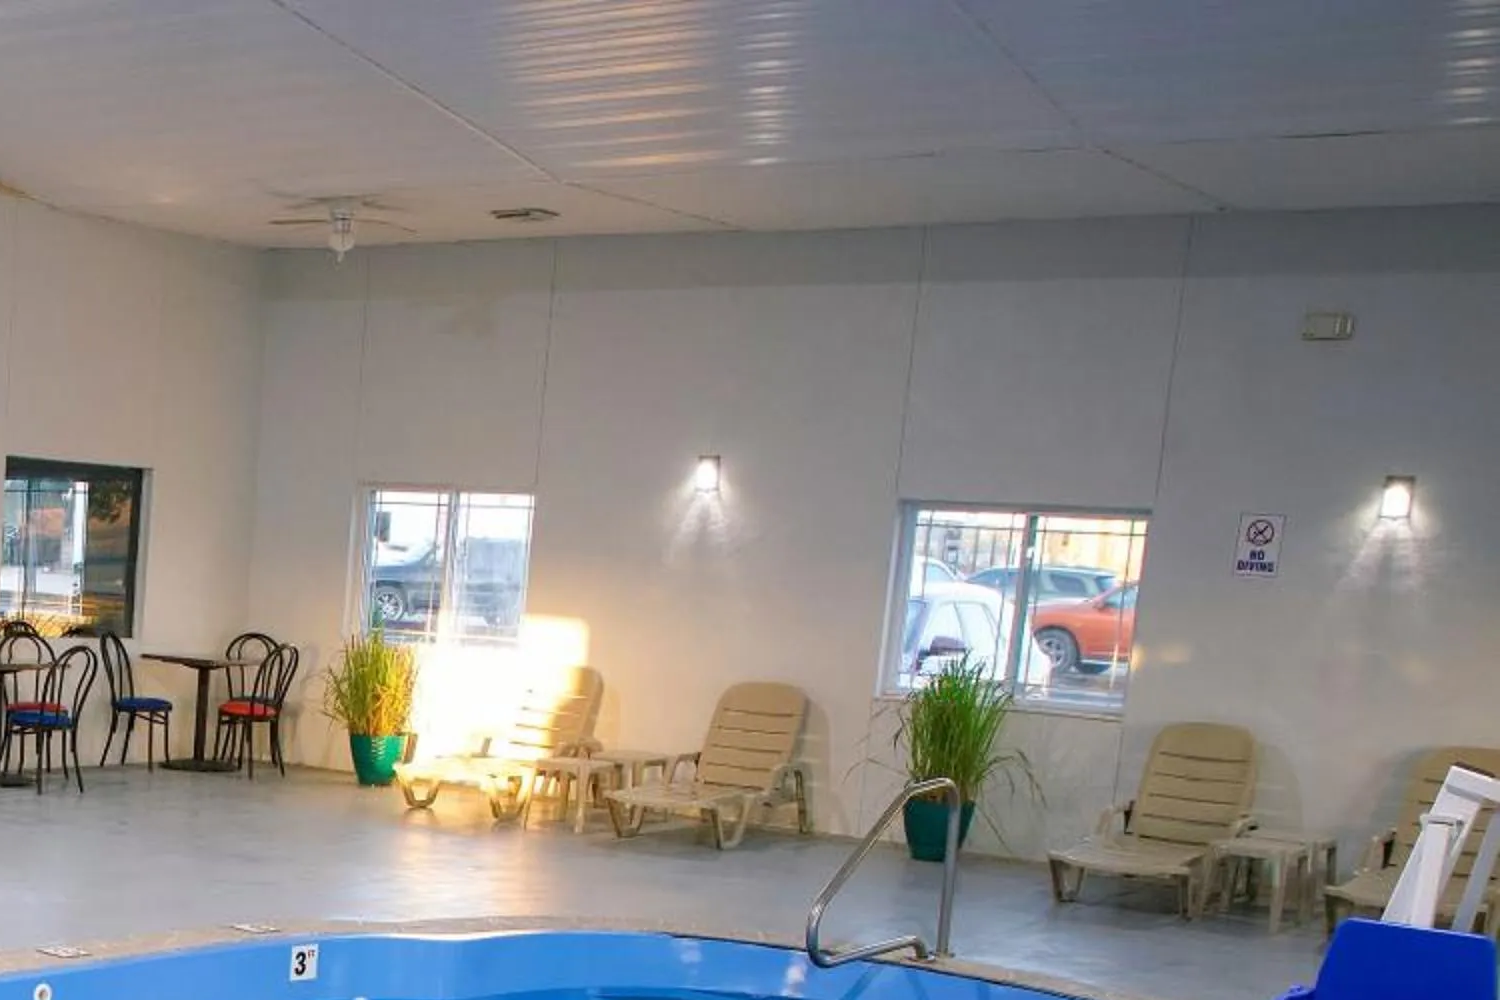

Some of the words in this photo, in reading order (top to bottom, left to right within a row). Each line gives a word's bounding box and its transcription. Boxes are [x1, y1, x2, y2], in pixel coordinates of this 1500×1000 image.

[1249, 550, 1265, 561] NO
[1236, 560, 1275, 573] DIVING
[294, 951, 307, 976] 3
